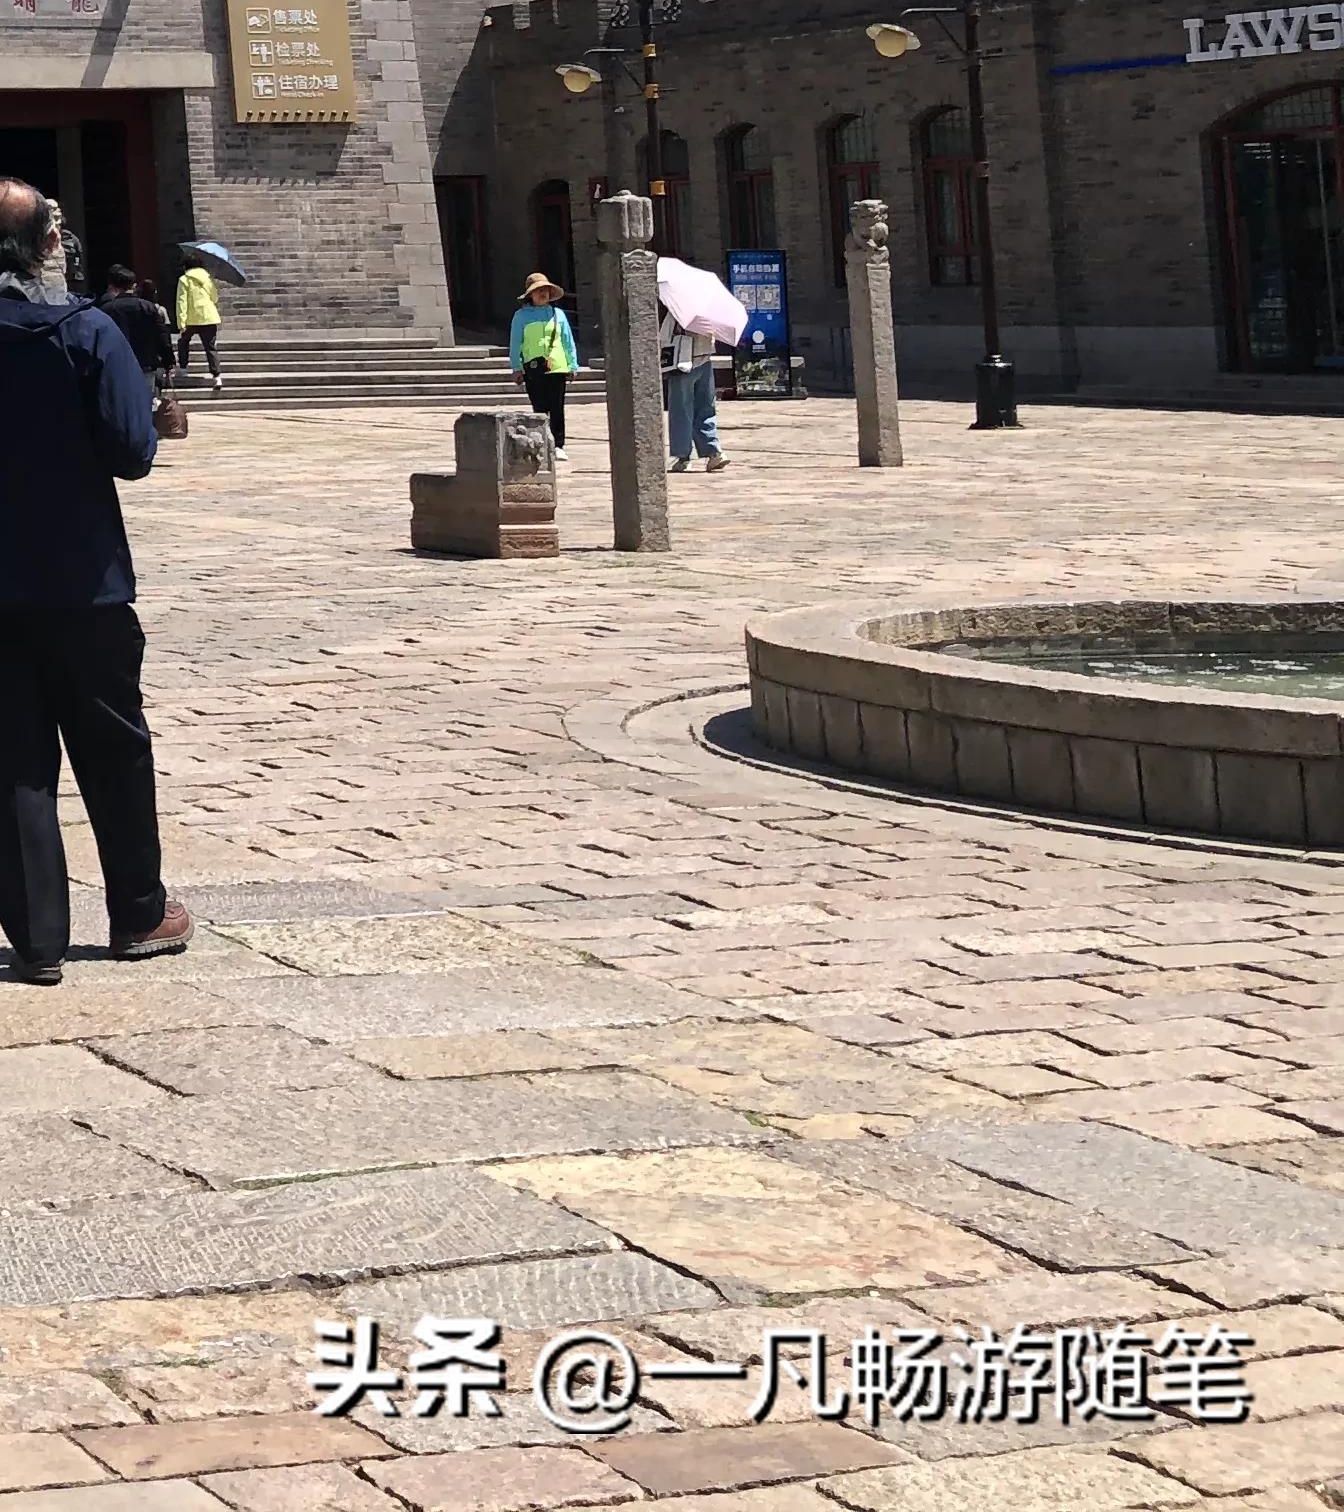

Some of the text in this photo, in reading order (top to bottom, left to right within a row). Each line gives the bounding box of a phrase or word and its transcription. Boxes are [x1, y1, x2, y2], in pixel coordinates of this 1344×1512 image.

[273, 9, 318, 25] 售票处
[1182, 3, 1344, 63] LAWS
[275, 41, 321, 57] 检票处
[279, 74, 339, 90] 住宿办理
